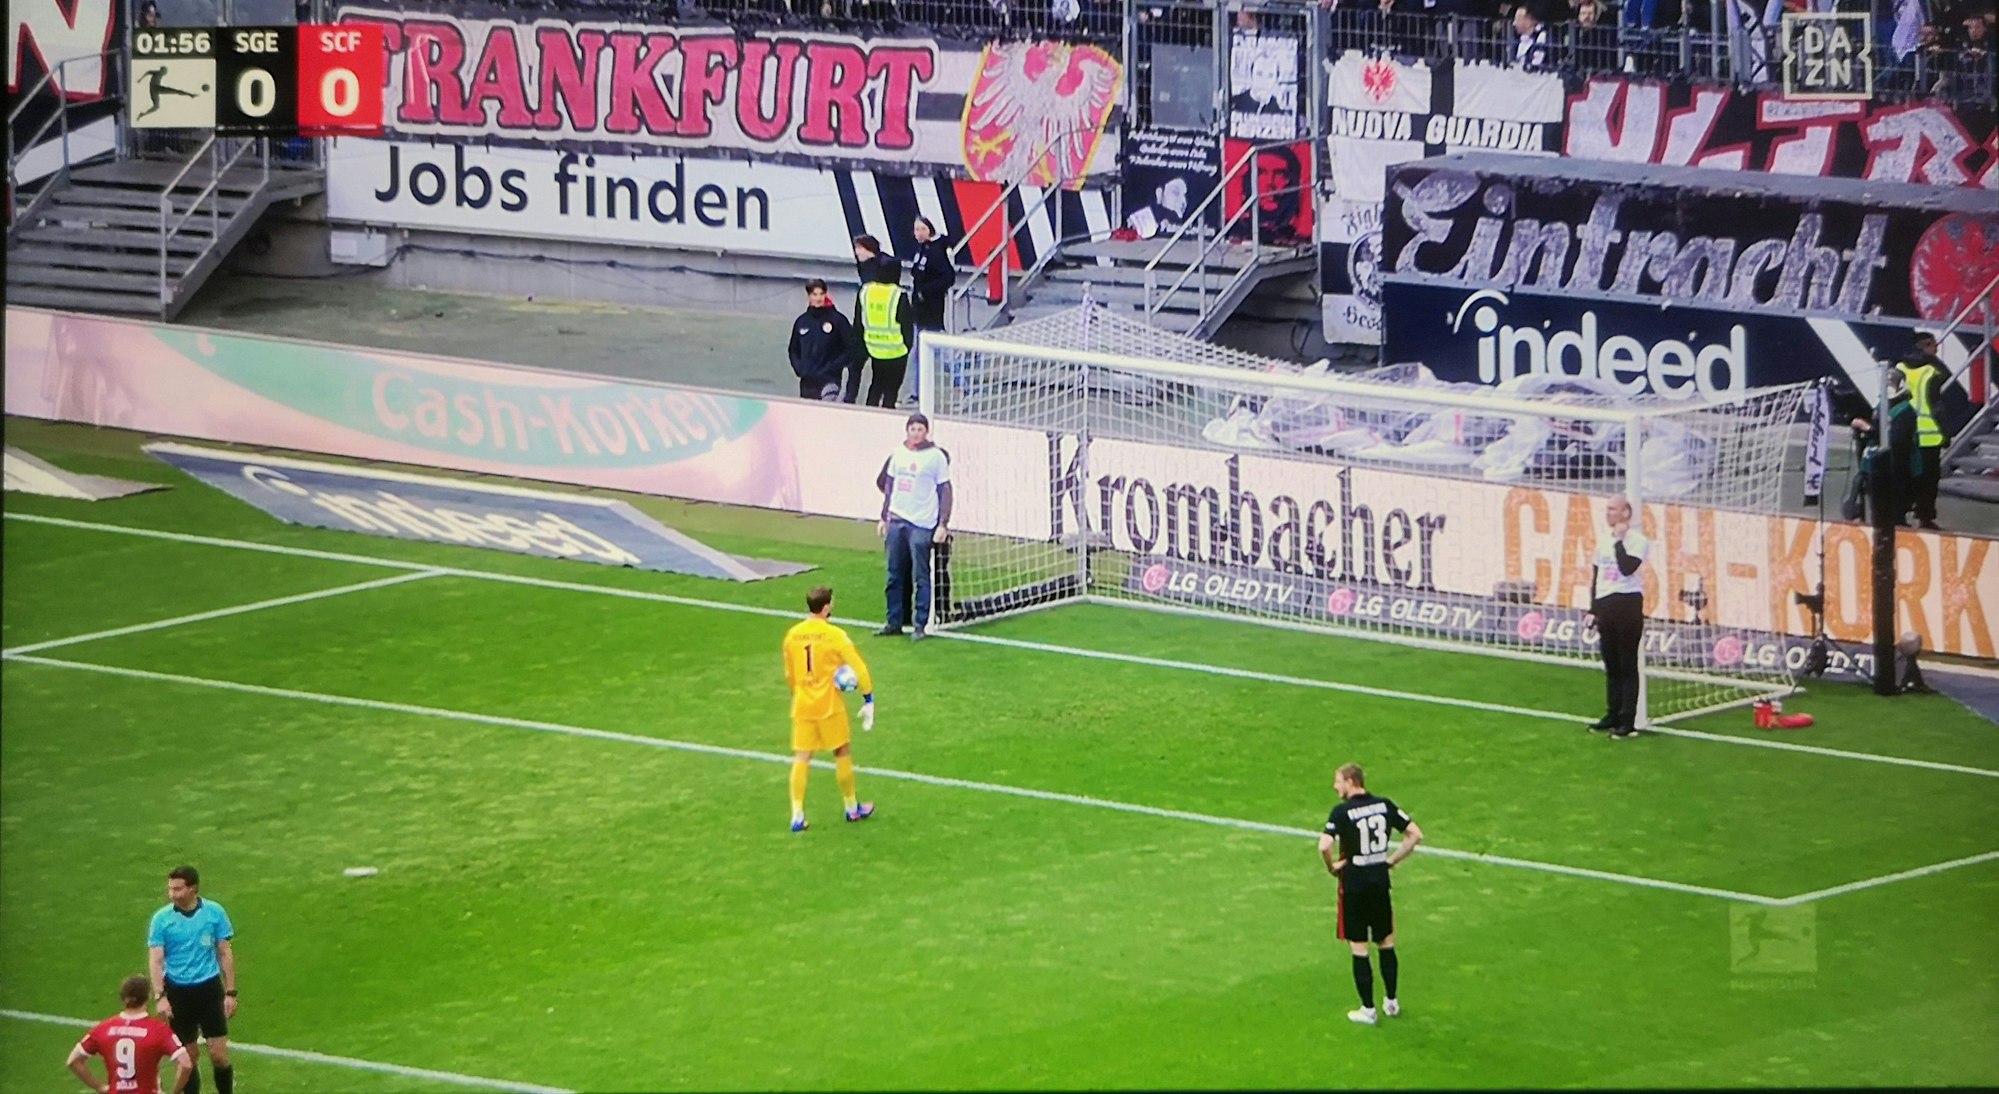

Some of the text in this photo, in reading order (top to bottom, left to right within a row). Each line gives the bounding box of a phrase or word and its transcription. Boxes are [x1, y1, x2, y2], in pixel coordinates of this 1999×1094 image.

[136, 32, 210, 54] 01:56
[235, 31, 362, 53] SGE SCF
[238, 67, 360, 118] 0 0
[1331, 107, 1544, 152] NUOVA GUARDIA
[1563, 75, 1998, 189] ULTR
[374, 145, 771, 231] Jobs finden
[1393, 170, 1889, 314] Eintracht
[1474, 303, 1747, 402] indeed
[372, 370, 732, 457] Cash-Korken
[262, 470, 641, 564] indeed
[1047, 430, 1447, 592] Krombacher
[1167, 570, 1296, 605] LG OLED TV
[1353, 594, 1483, 630] LG OLED TV
[1543, 618, 1576, 642] LG
[1644, 630, 1677, 653] TV
[1743, 643, 1777, 667] LG
[803, 643, 813, 673] 1
[1356, 813, 1388, 856] 13
[115, 1037, 136, 1080] 9
